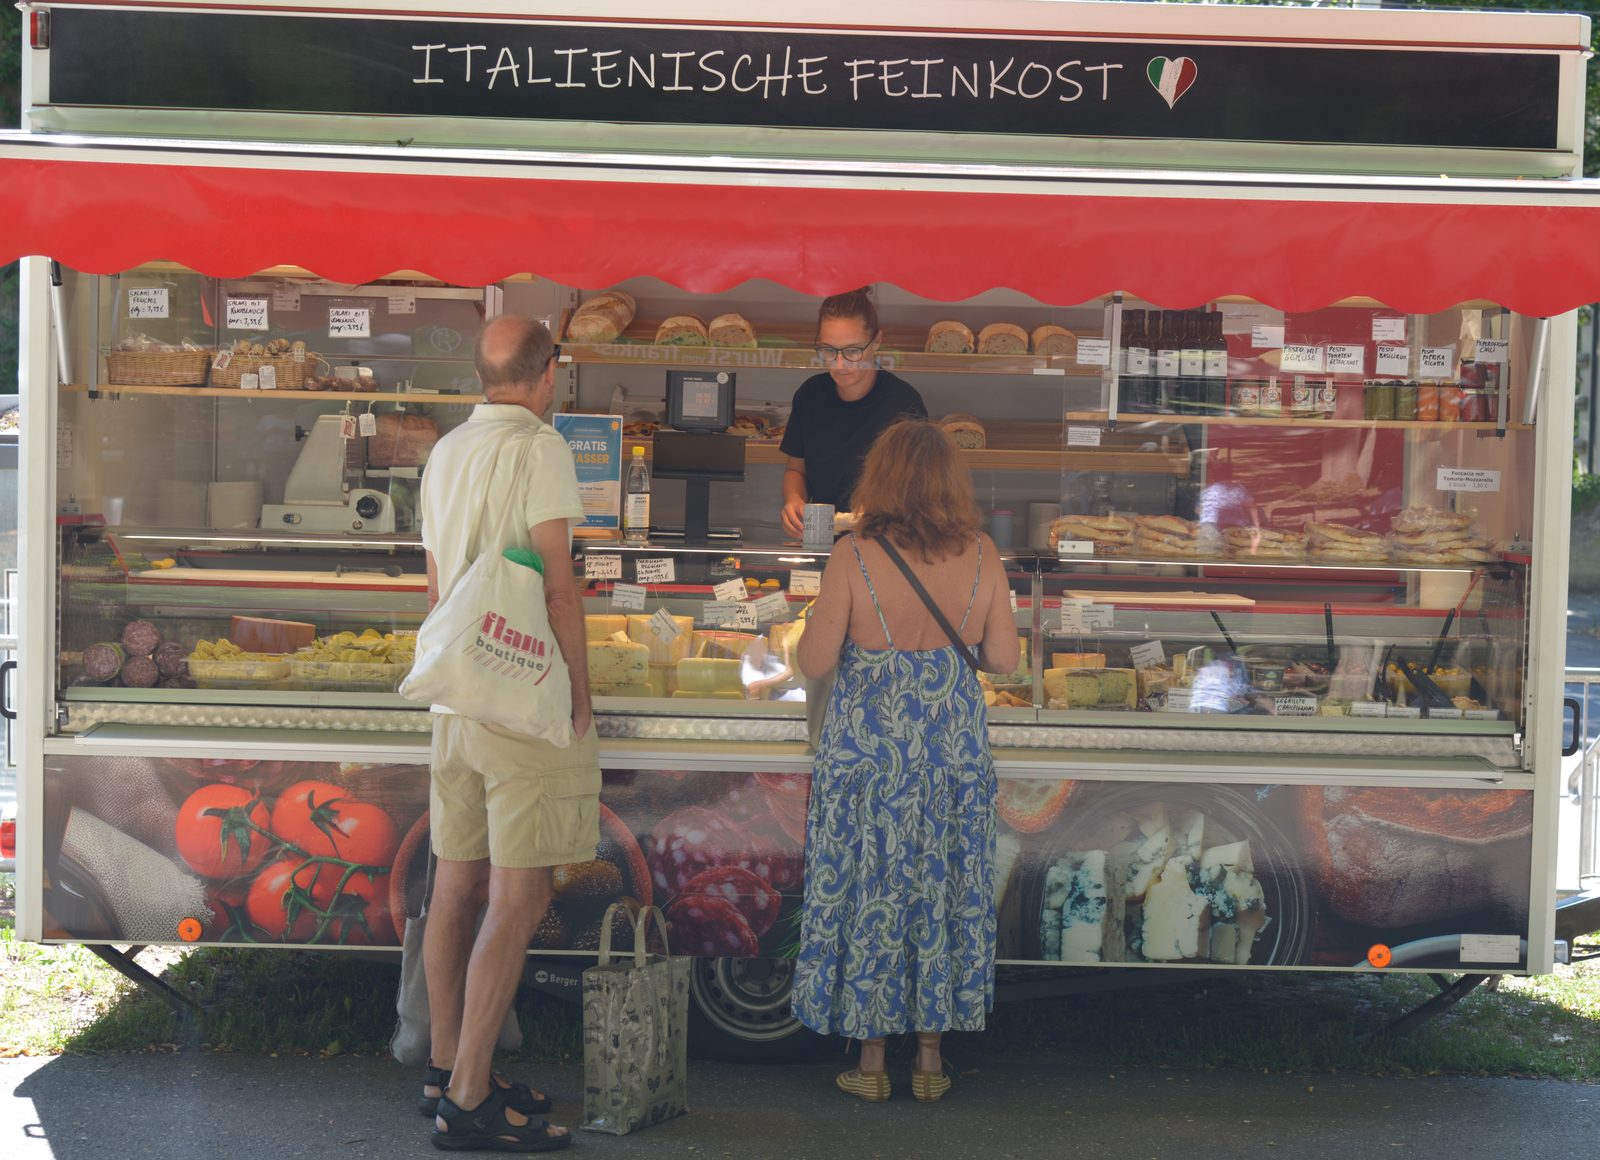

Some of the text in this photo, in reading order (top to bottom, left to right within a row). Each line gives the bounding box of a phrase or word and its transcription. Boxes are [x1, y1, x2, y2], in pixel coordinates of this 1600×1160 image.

[411, 43, 1123, 101] ITALIENISCHE FEINKOST
[568, 440, 607, 451] GRATIS
[574, 453, 609, 464] ASSER
[475, 635, 545, 672] boutique
[550, 973, 578, 986] Berger
